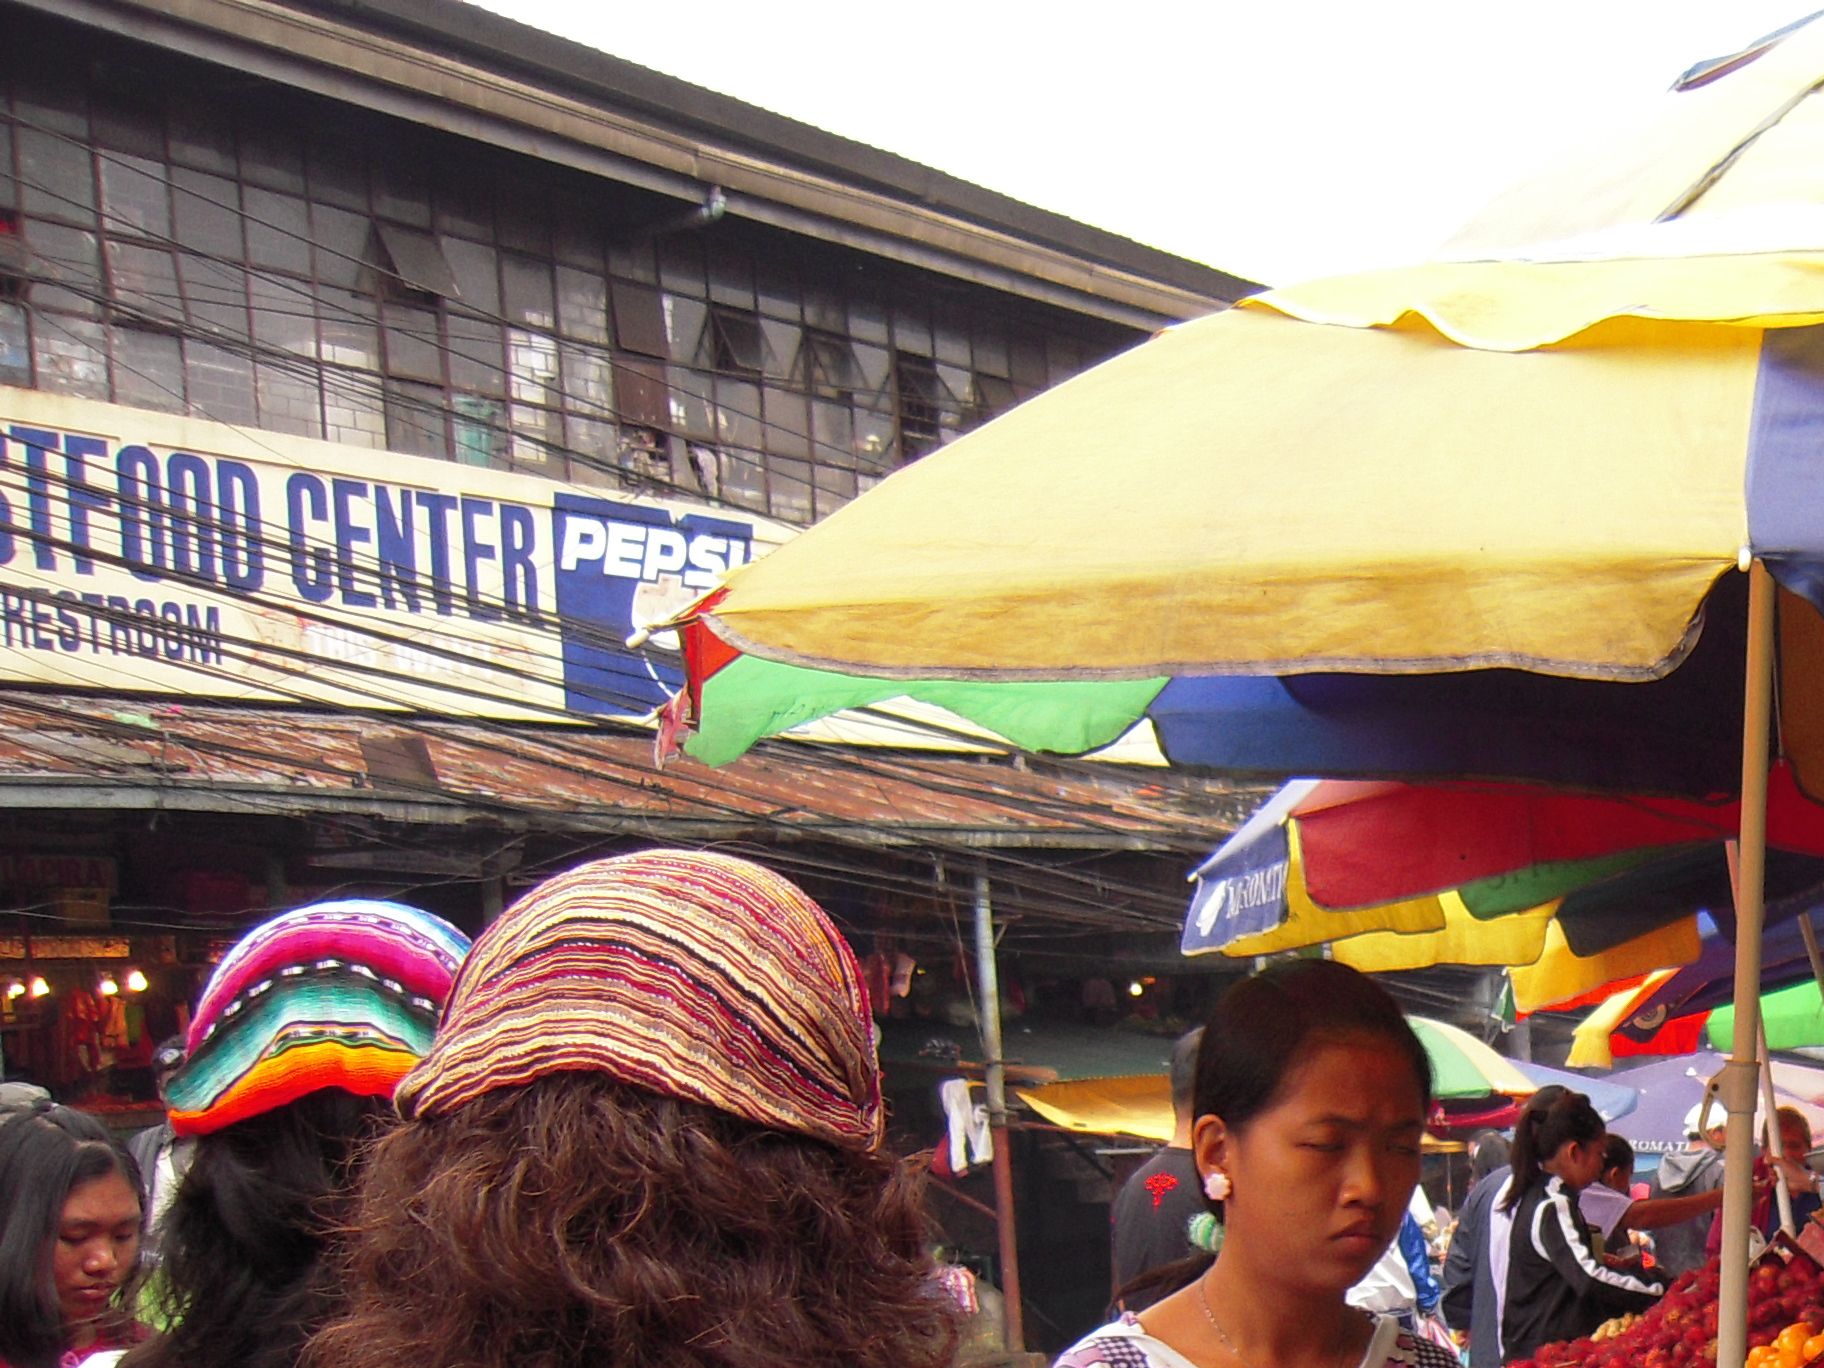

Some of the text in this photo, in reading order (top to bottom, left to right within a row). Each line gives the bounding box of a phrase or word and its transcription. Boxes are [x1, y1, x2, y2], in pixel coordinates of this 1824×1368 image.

[286, 472, 546, 628] CENTER
[2, 587, 223, 666] RESTROOM
[1628, 1138, 1691, 1152] ROMATI
